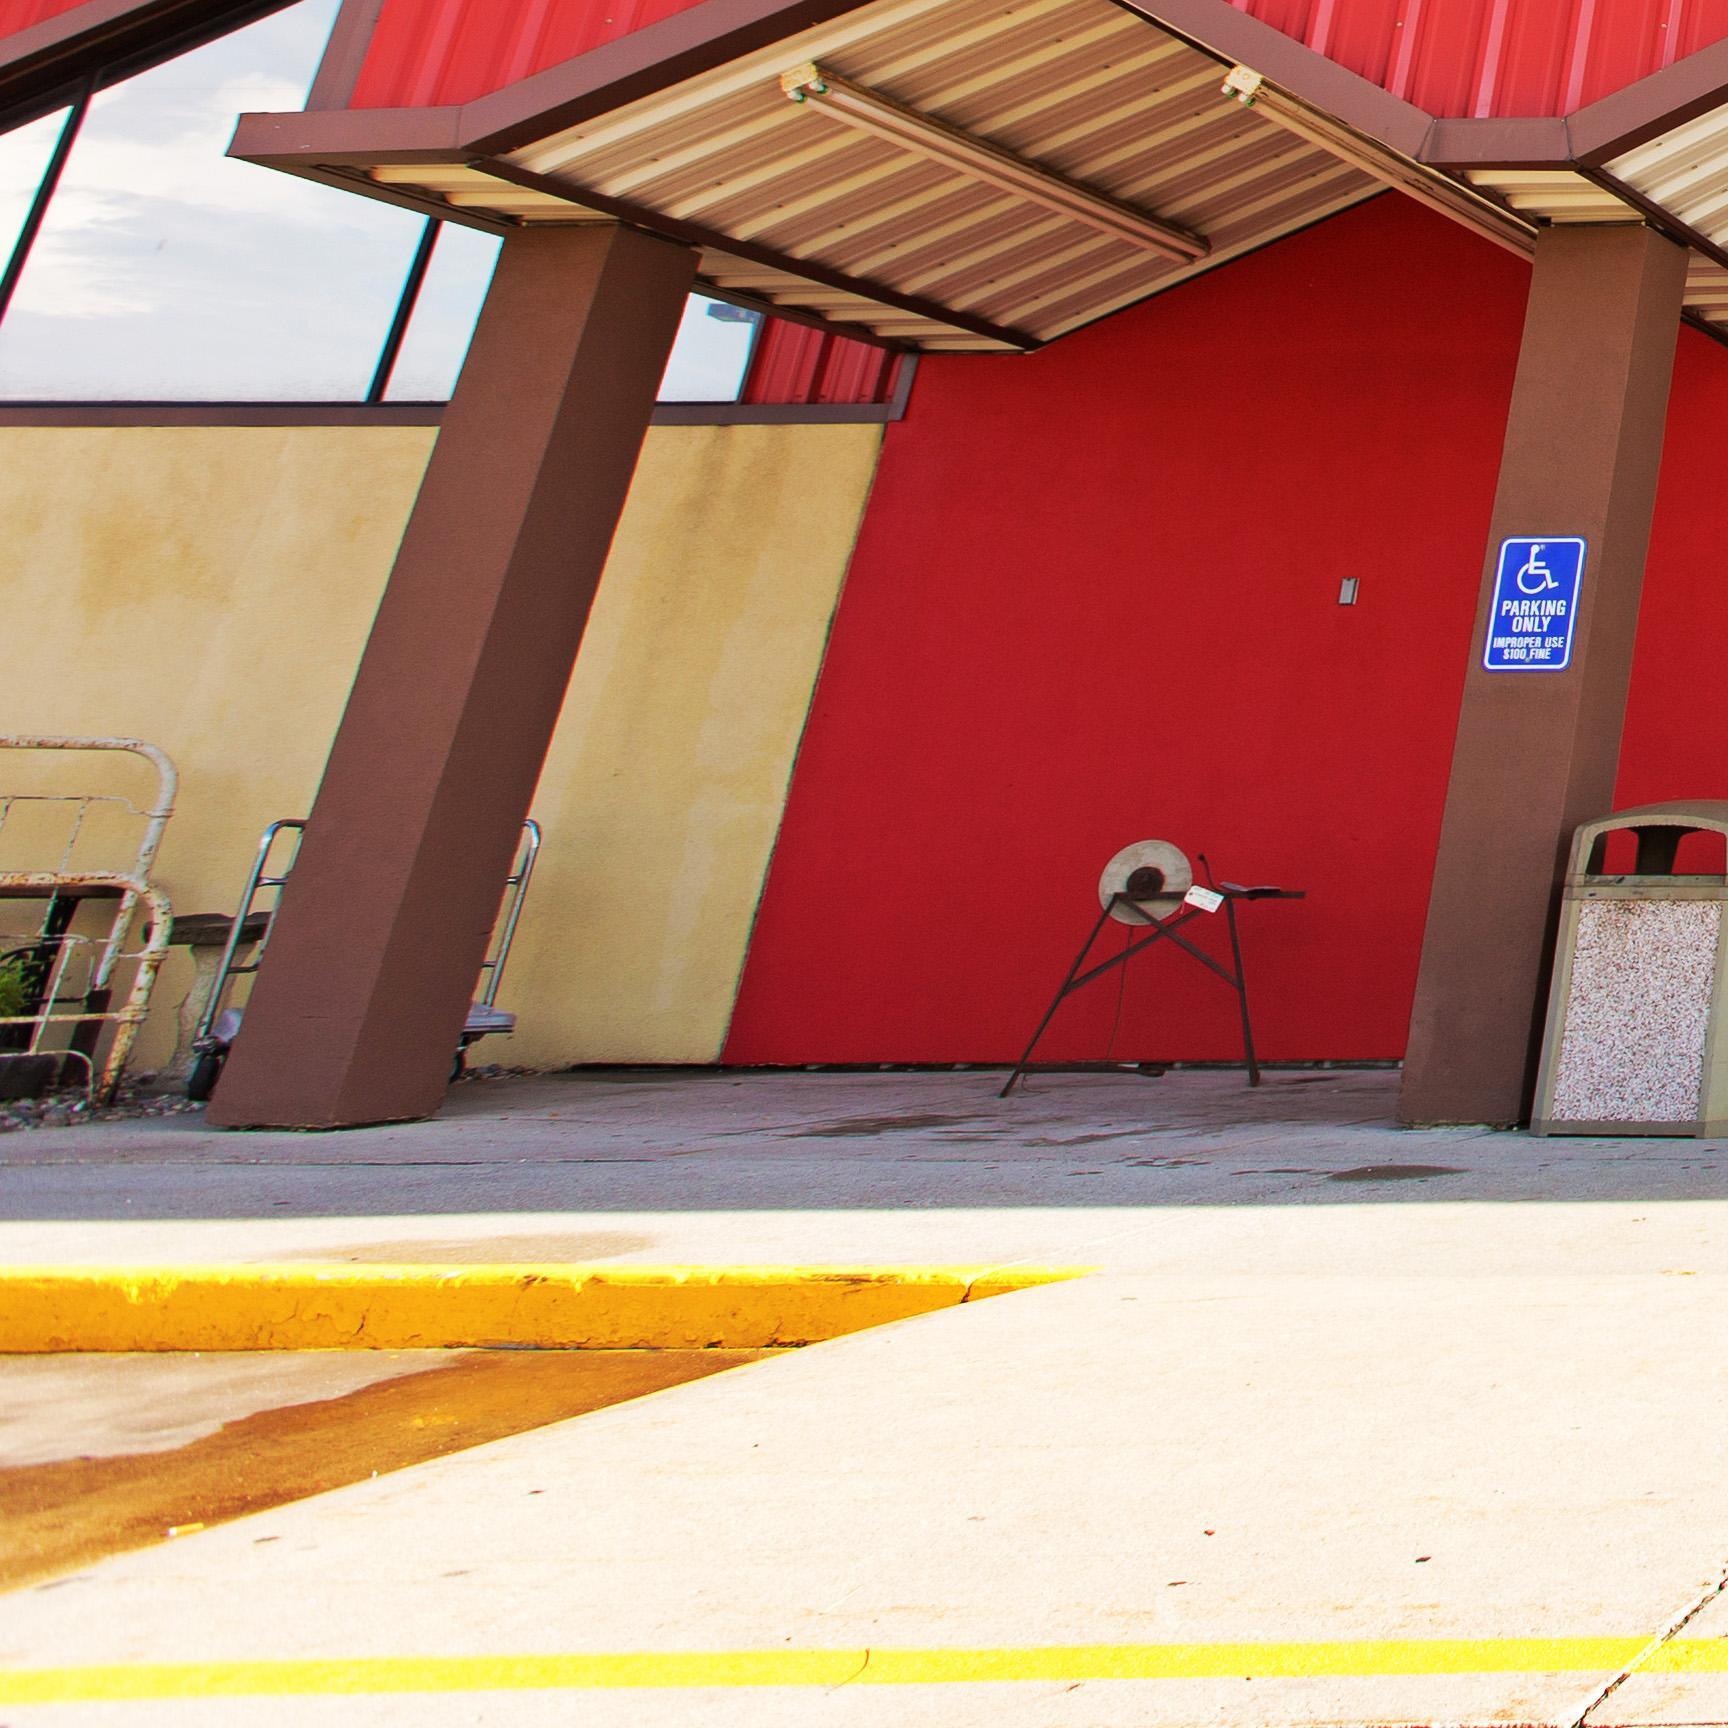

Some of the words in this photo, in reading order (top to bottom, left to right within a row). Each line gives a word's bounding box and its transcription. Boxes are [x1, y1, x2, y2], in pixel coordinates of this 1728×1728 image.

[1501, 600, 1567, 616] PARKING
[1511, 616, 1552, 633] ONLY
[1493, 636, 1542, 649] IMPROPER
[1544, 636, 1565, 648] USE
